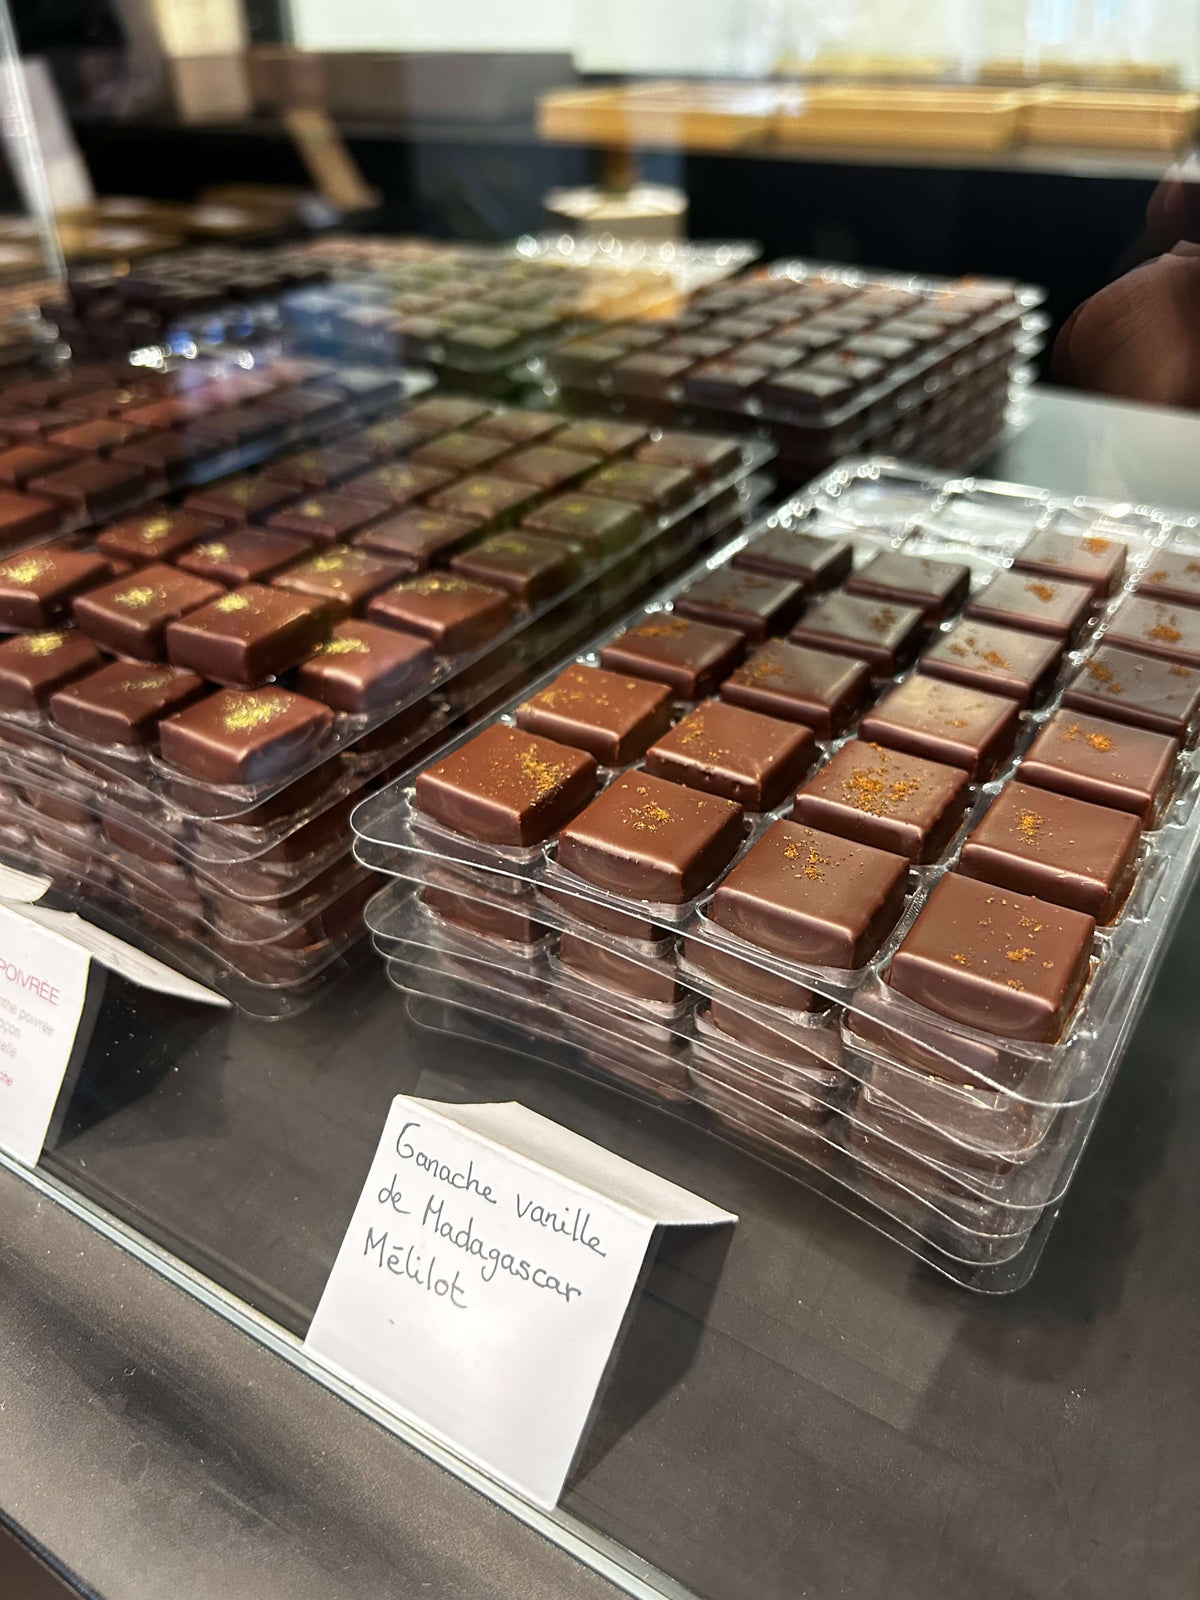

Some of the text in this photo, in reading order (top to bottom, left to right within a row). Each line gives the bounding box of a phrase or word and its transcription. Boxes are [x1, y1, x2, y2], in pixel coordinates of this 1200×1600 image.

[396, 1122, 497, 1204] Ganache
[363, 1227, 468, 1309] Mélilot
[378, 1173, 582, 1302] de Madagascar
